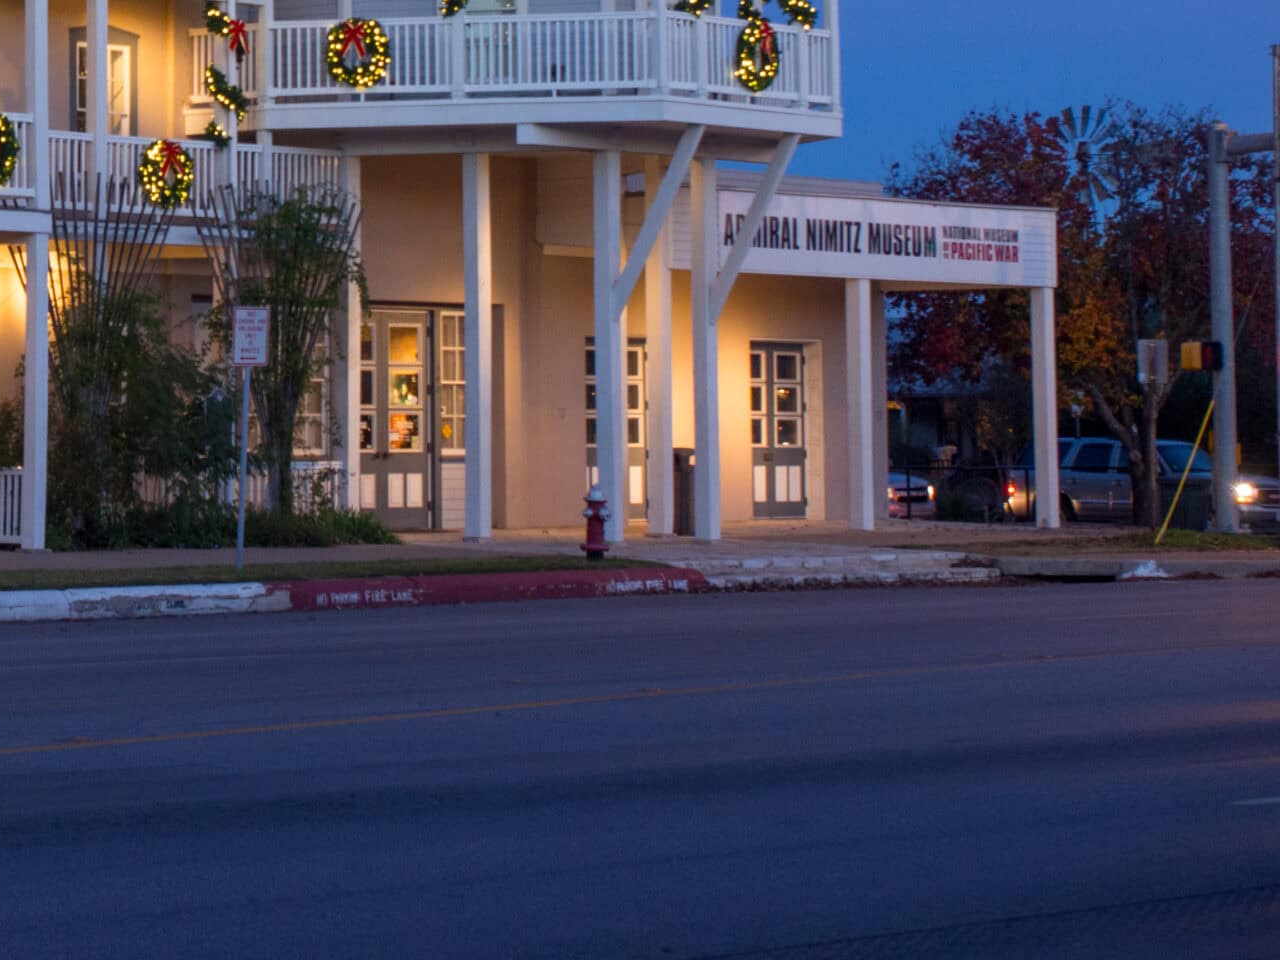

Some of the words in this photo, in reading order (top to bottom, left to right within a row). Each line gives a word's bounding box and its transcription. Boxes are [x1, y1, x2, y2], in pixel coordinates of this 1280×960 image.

[806, 218, 861, 254] NIMITZ
[867, 222, 937, 258] MUSEUM
[951, 241, 993, 261] PACIFIC
[993, 243, 1019, 263] WAR
[364, 589, 385, 602] FIRE
[390, 588, 412, 601] LANE
